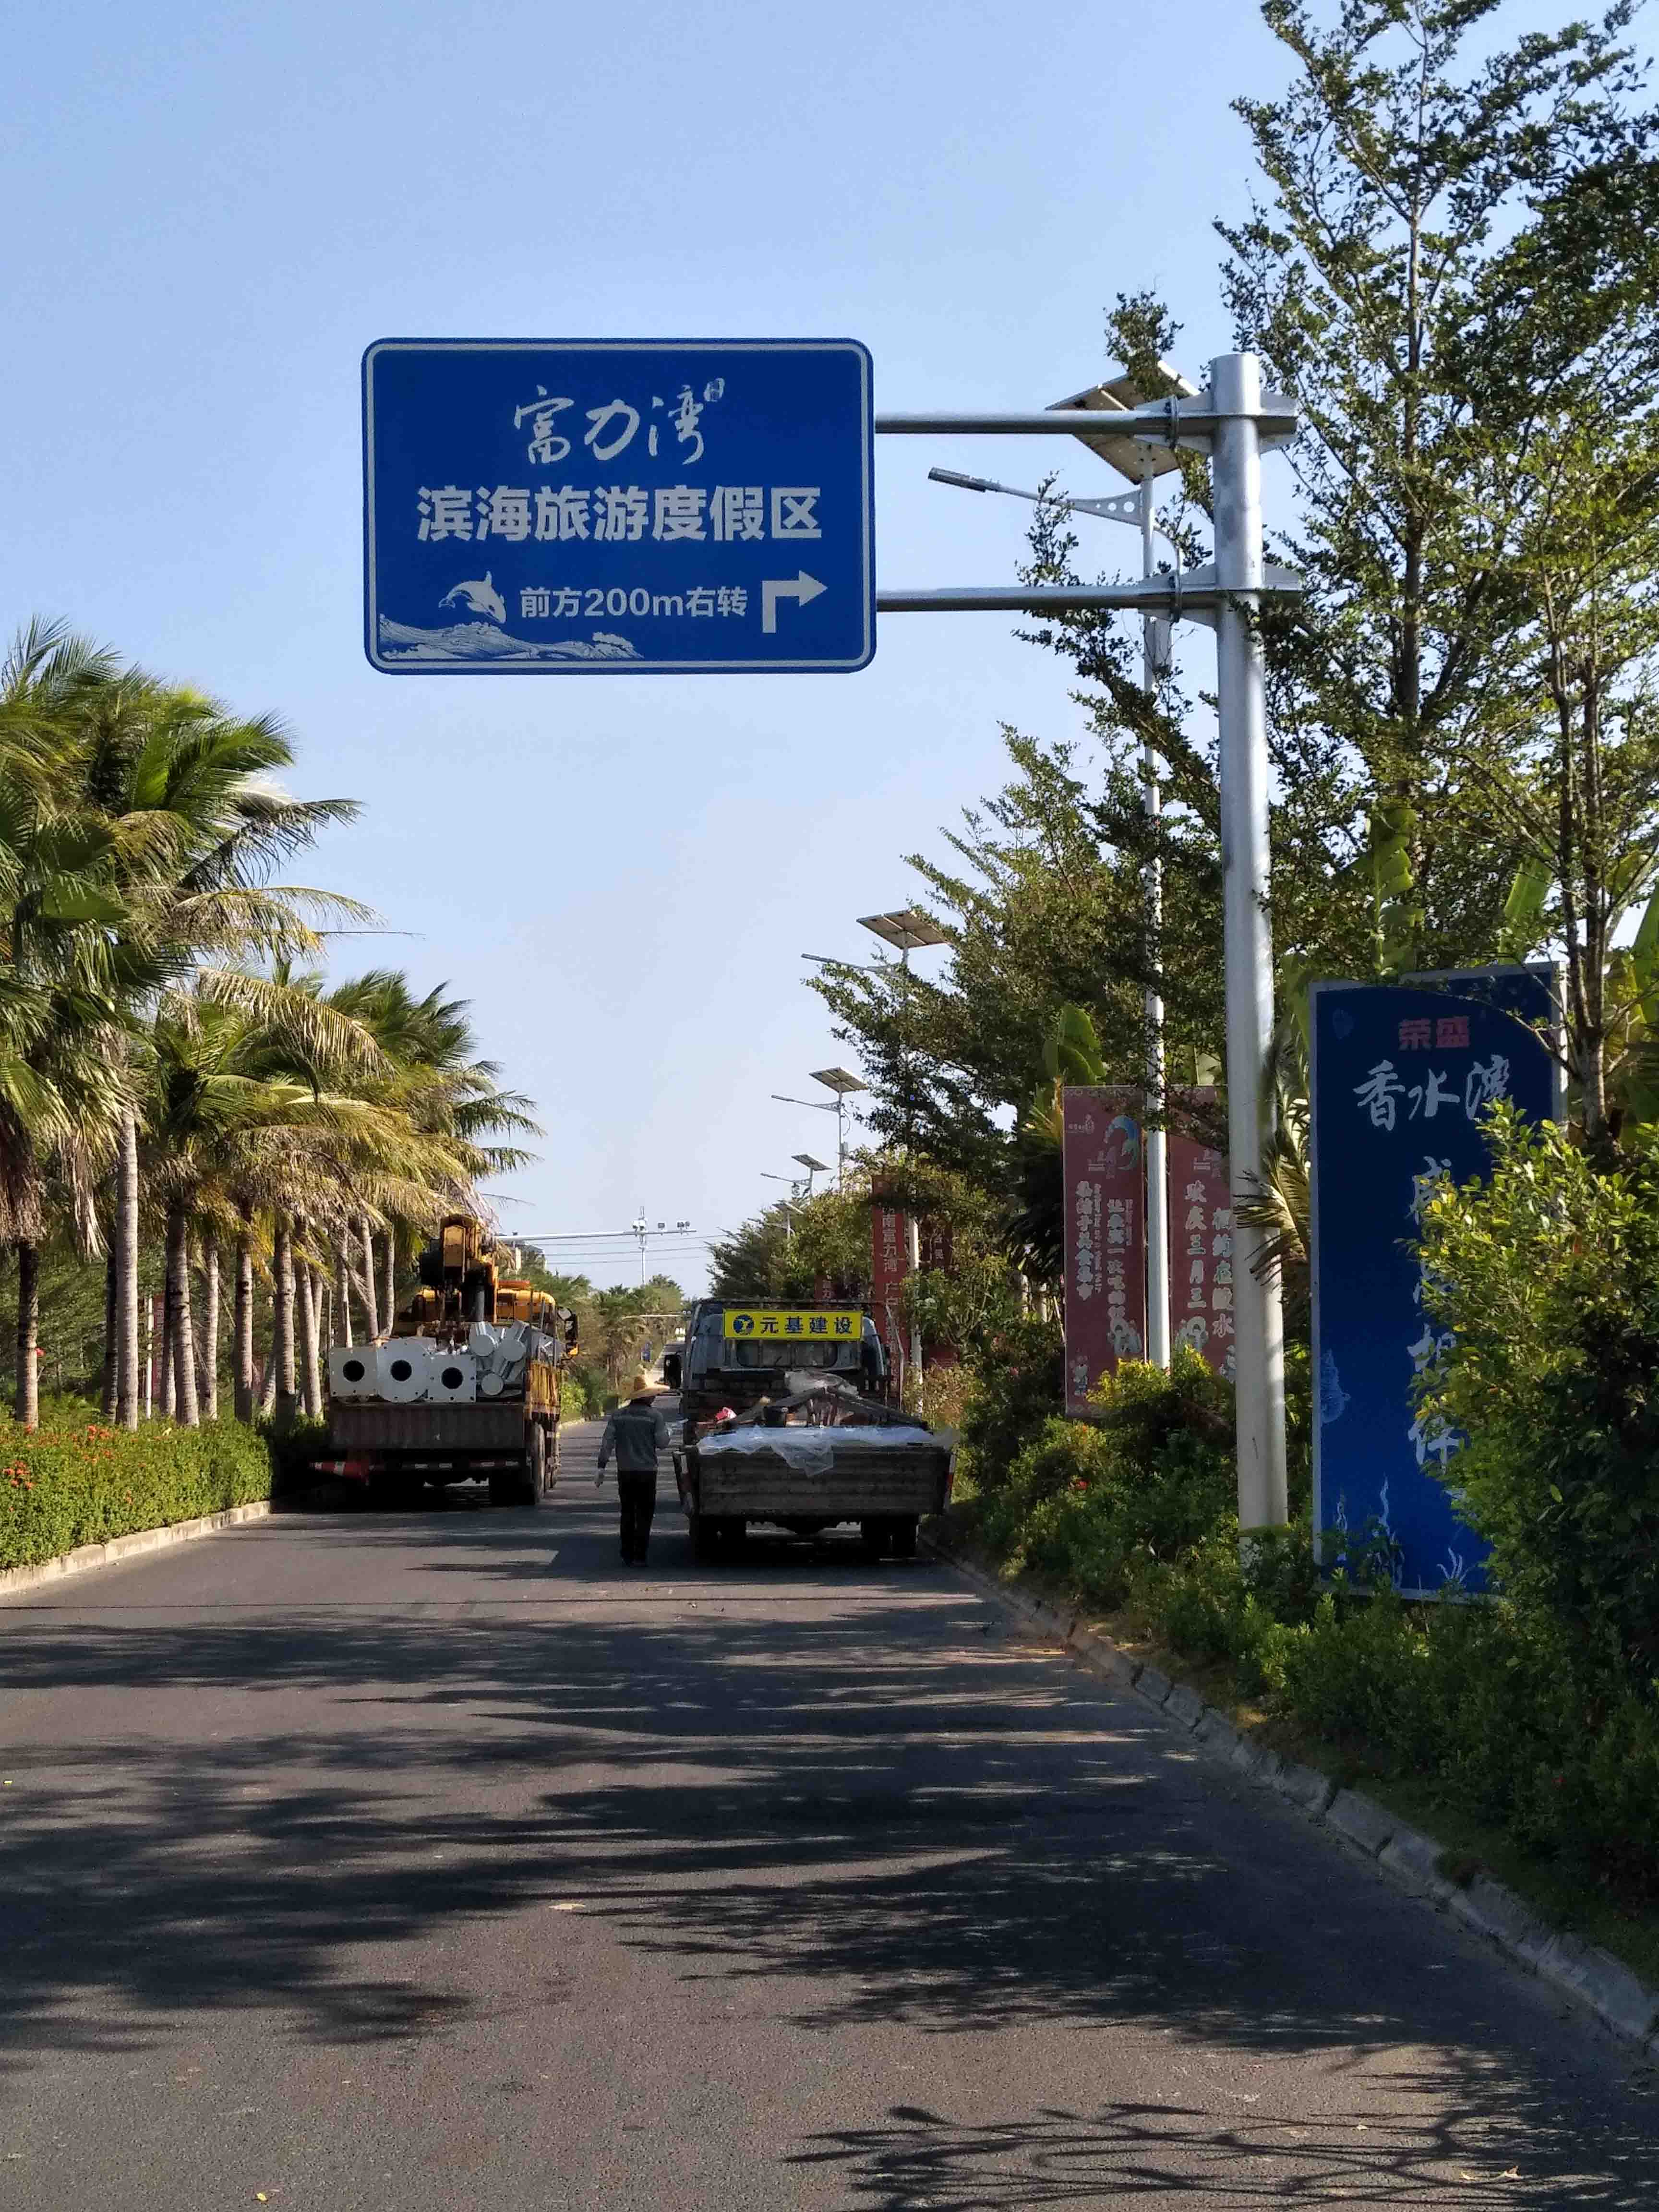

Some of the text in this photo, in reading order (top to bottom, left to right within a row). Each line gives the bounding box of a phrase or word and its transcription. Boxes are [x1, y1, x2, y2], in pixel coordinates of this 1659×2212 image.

[514, 385, 704, 464] 富力湾
[417, 485, 822, 541] 滨海旅游度假区
[520, 586, 747, 618] 前方200m右转
[760, 1316, 853, 1334] 元基建设
